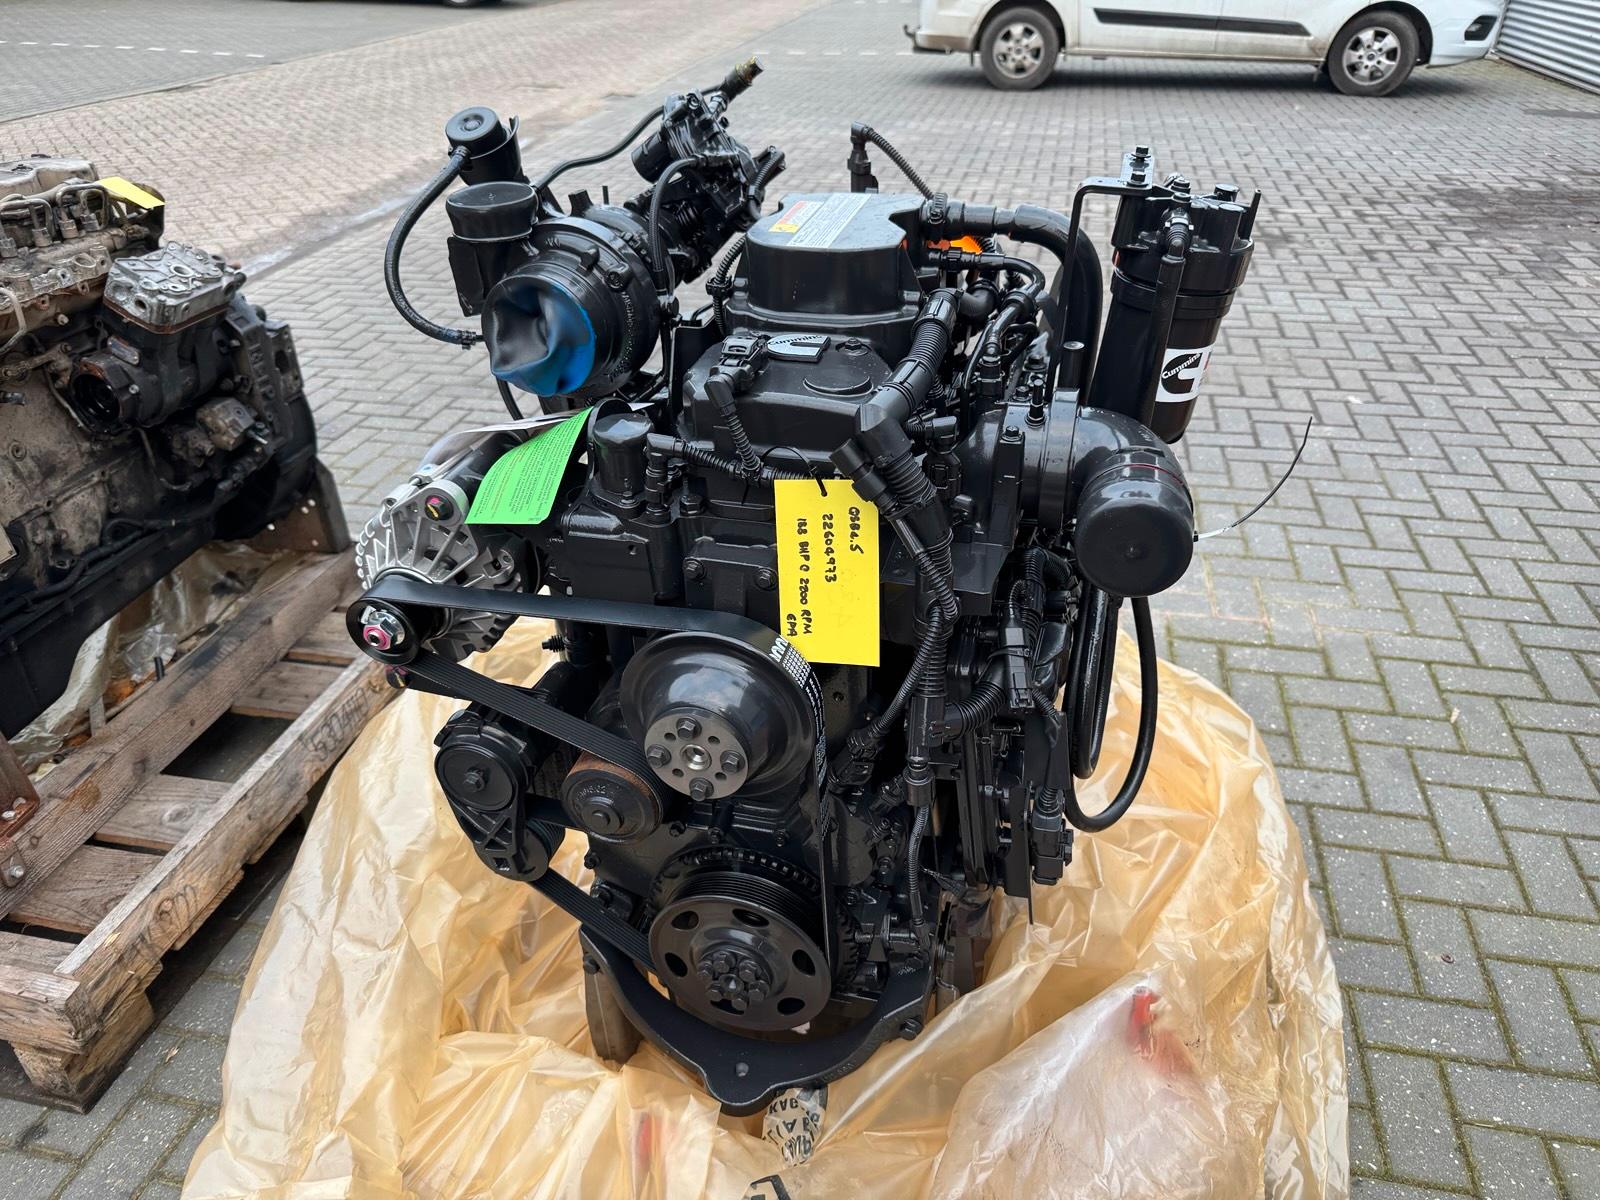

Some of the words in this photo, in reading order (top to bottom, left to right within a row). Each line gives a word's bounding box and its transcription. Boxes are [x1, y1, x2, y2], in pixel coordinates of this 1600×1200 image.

[1161, 353, 1201, 379] Cummins
[786, 613, 798, 637] EPA
[801, 609, 813, 634] RPM
